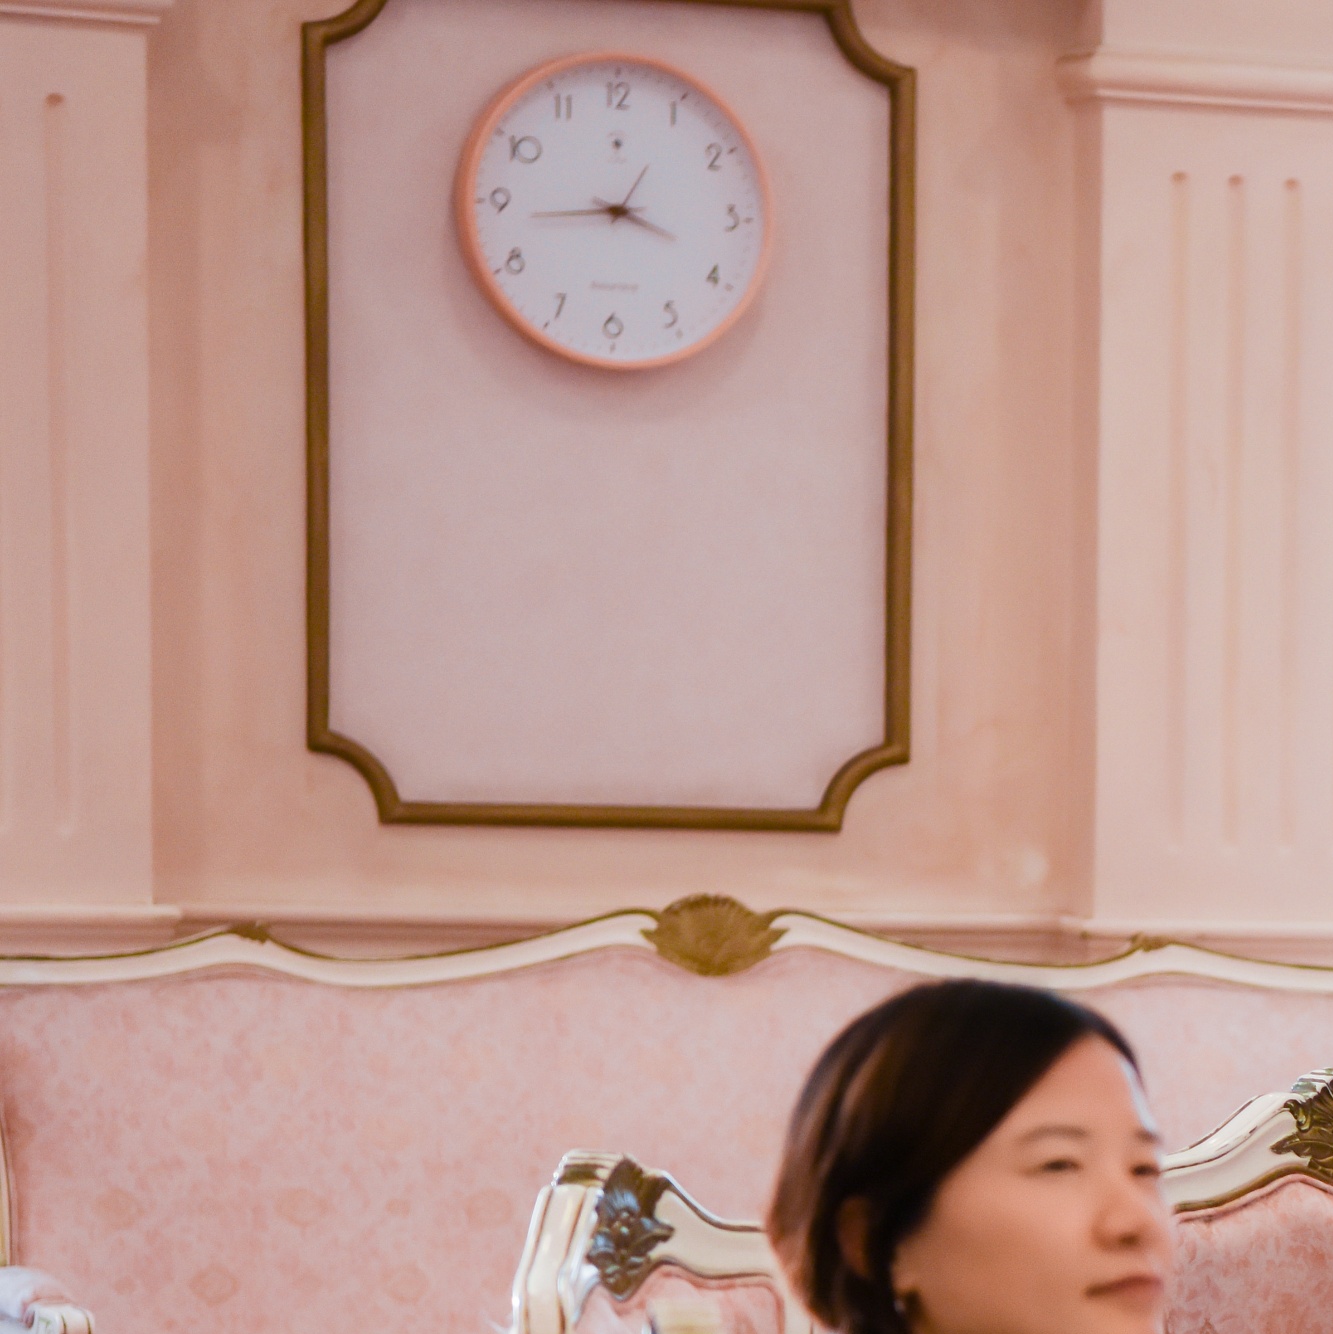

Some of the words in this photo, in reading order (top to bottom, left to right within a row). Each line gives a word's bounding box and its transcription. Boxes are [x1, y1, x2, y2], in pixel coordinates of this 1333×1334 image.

[554, 94, 572, 120] 11
[605, 82, 630, 110] 12
[509, 135, 543, 164] 10
[705, 143, 723, 171] 2
[489, 187, 512, 214] 9
[724, 204, 740, 232] 3
[504, 246, 525, 275] 8
[706, 264, 720, 287] 4
[554, 292, 567, 319] 7
[664, 300, 679, 329] 5
[602, 312, 624, 340] 6
